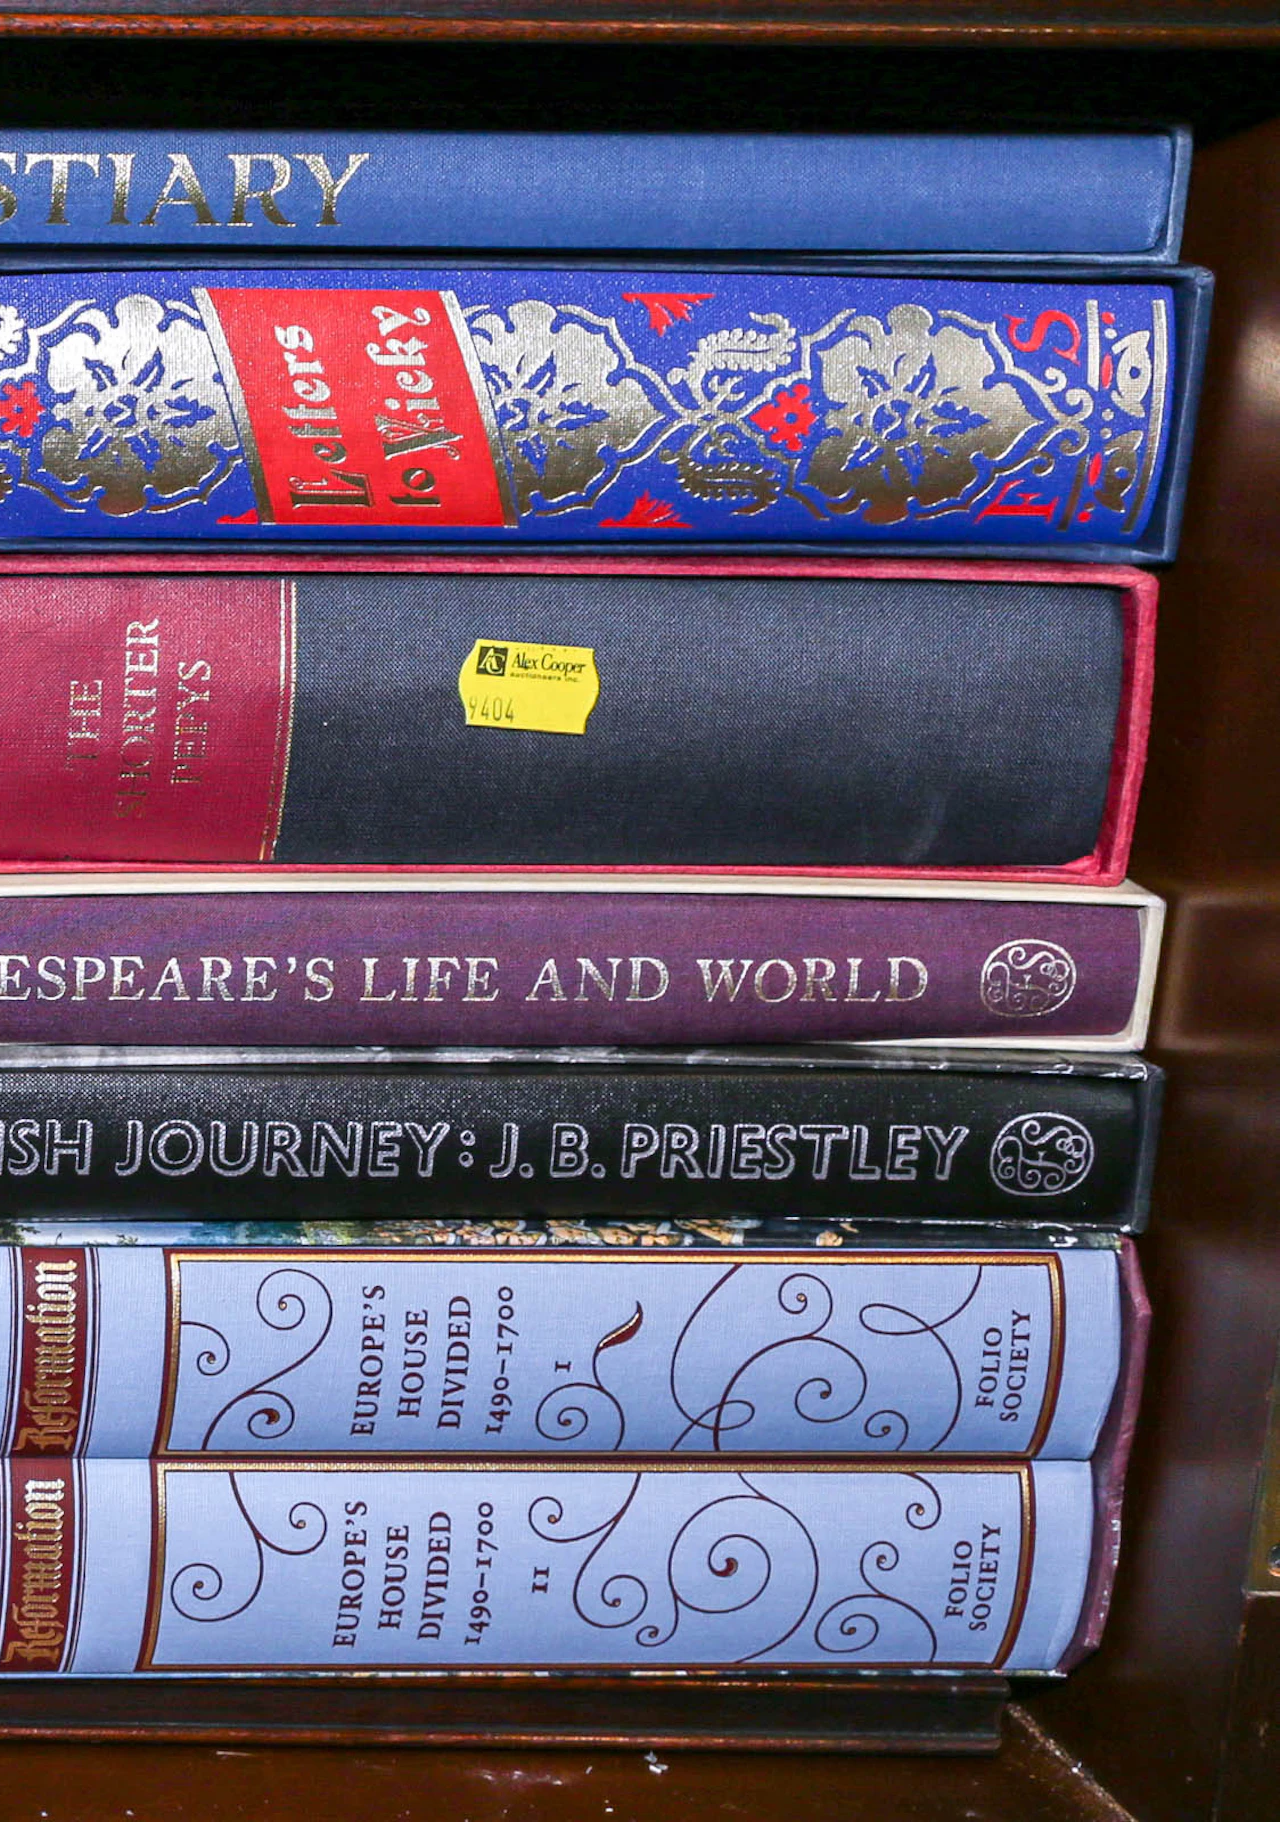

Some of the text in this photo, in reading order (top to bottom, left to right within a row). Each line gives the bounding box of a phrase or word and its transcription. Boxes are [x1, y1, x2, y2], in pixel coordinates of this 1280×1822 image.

[274, 325, 375, 510] Letters
[114, 618, 159, 818] SHORTER
[469, 696, 514, 722] 9404
[512, 652, 587, 676] Alex Cooper
[64, 679, 103, 771] THE
[171, 660, 211, 784] PEPYS
[361, 956, 500, 1003] LIFE
[525, 957, 670, 1003] AND
[697, 957, 930, 1004] WORLD
[489, 1122, 535, 1180] J.
[550, 1122, 605, 1180] B.
[620, 1122, 970, 1181] PRIESTLEY
[14, 1260, 78, 1452] Reformation
[350, 1284, 386, 1437] EUROPE'S
[395, 1308, 428, 1419] HOUSE
[436, 1294, 473, 1431] DIVIDED
[975, 1326, 1002, 1409] FOLIO
[1000, 1311, 1031, 1421] SOCIETY
[1, 1477, 65, 1665] Reformation
[332, 1500, 368, 1649] EUROPE'S
[377, 1525, 410, 1630] HOUSE
[416, 1510, 453, 1642] DIVIDED
[945, 1540, 972, 1619] FOLIO
[969, 1524, 1001, 1631] SOCIETY
